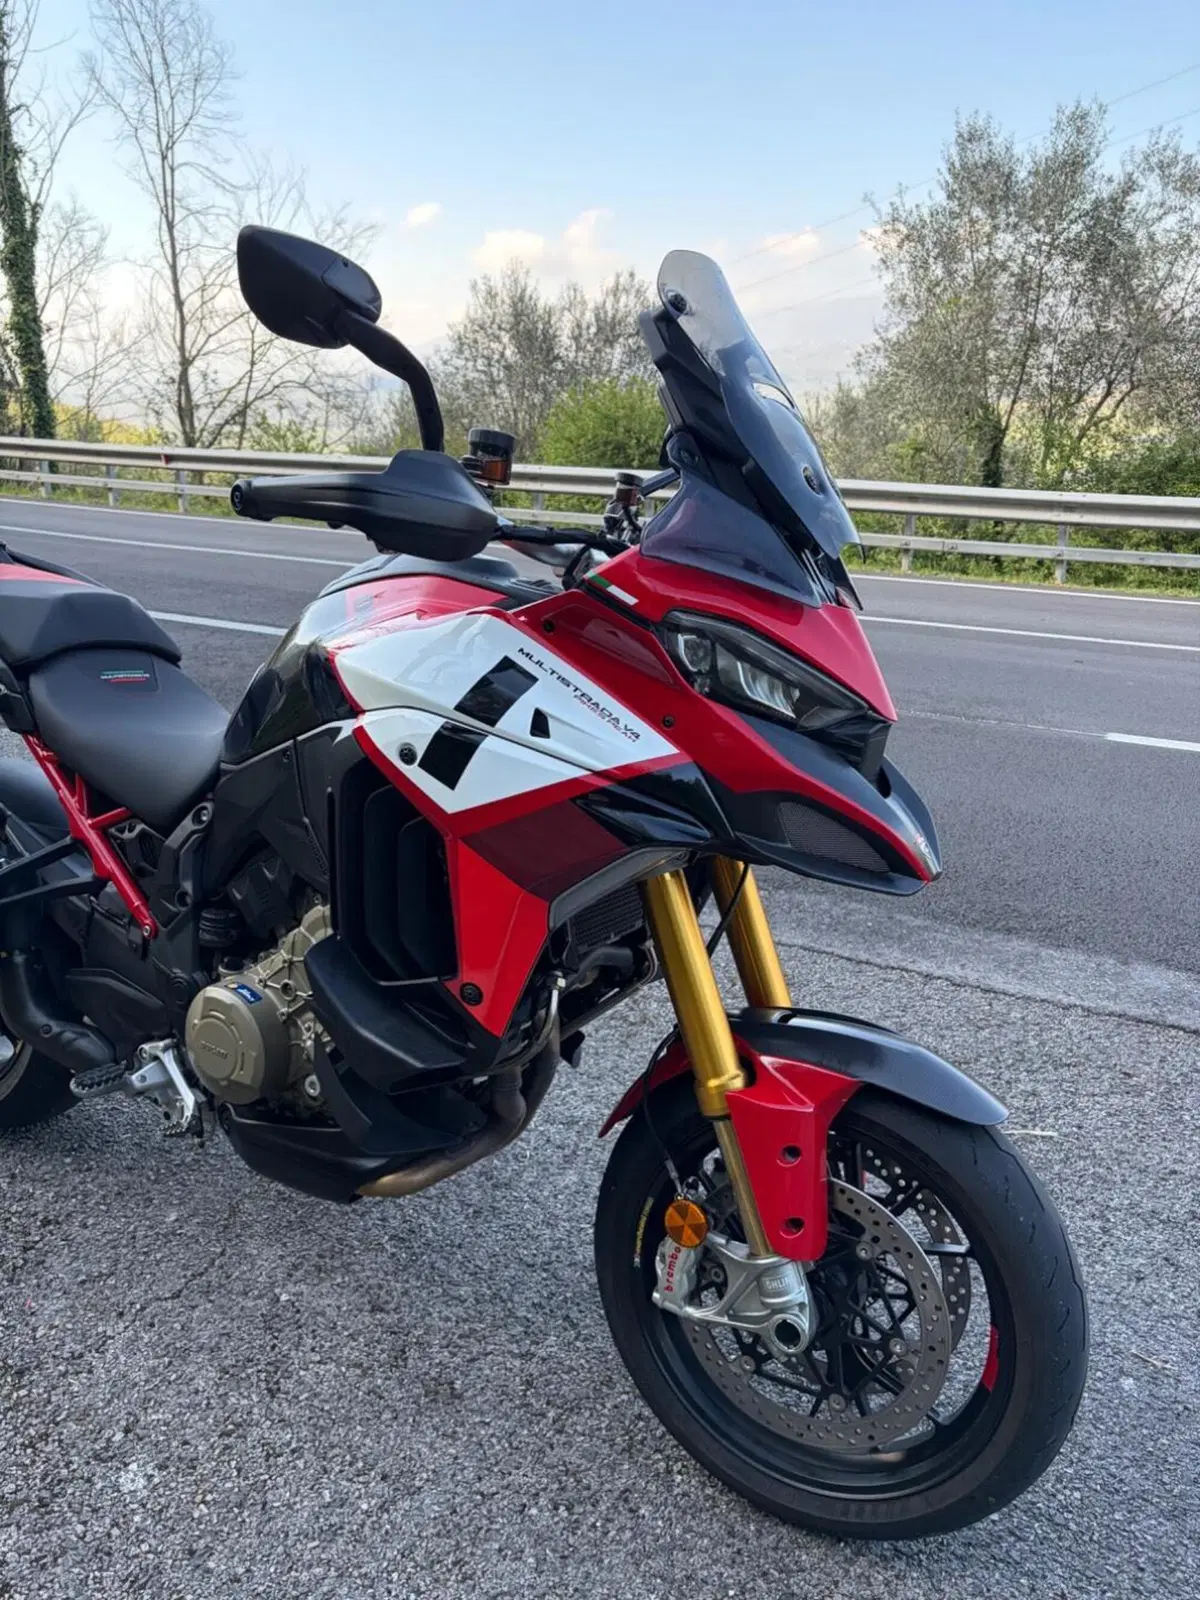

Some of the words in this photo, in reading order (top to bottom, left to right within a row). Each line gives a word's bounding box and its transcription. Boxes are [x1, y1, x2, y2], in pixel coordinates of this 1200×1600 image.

[517, 647, 621, 726] MULTISTRADA
[623, 724, 641, 741] V4
[664, 1246, 682, 1293] brembo
